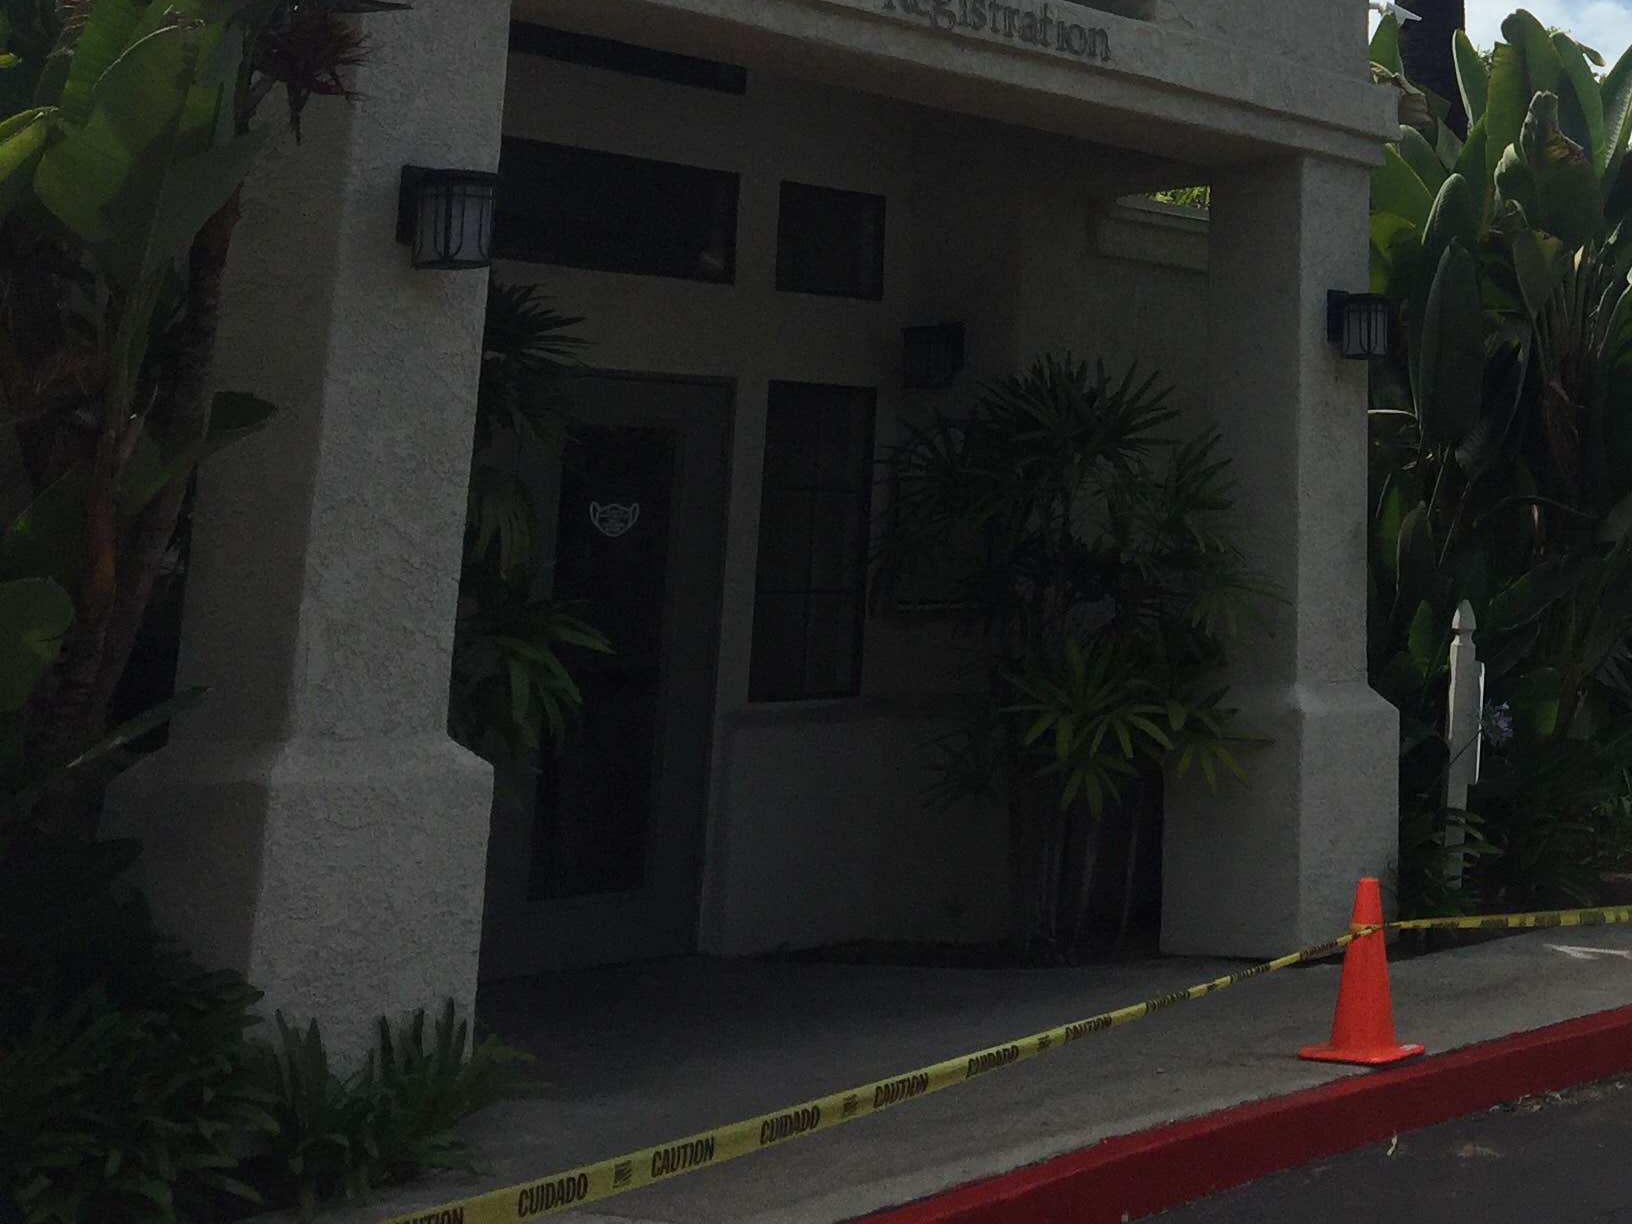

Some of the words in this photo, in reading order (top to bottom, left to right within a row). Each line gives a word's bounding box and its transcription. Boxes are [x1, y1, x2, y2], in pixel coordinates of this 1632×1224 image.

[518, 1173, 588, 1217] CUIDADO
[651, 1138, 714, 1177] CAUTION
[760, 1106, 821, 1145] CUIDADO
[873, 1073, 929, 1108] CAUTION
